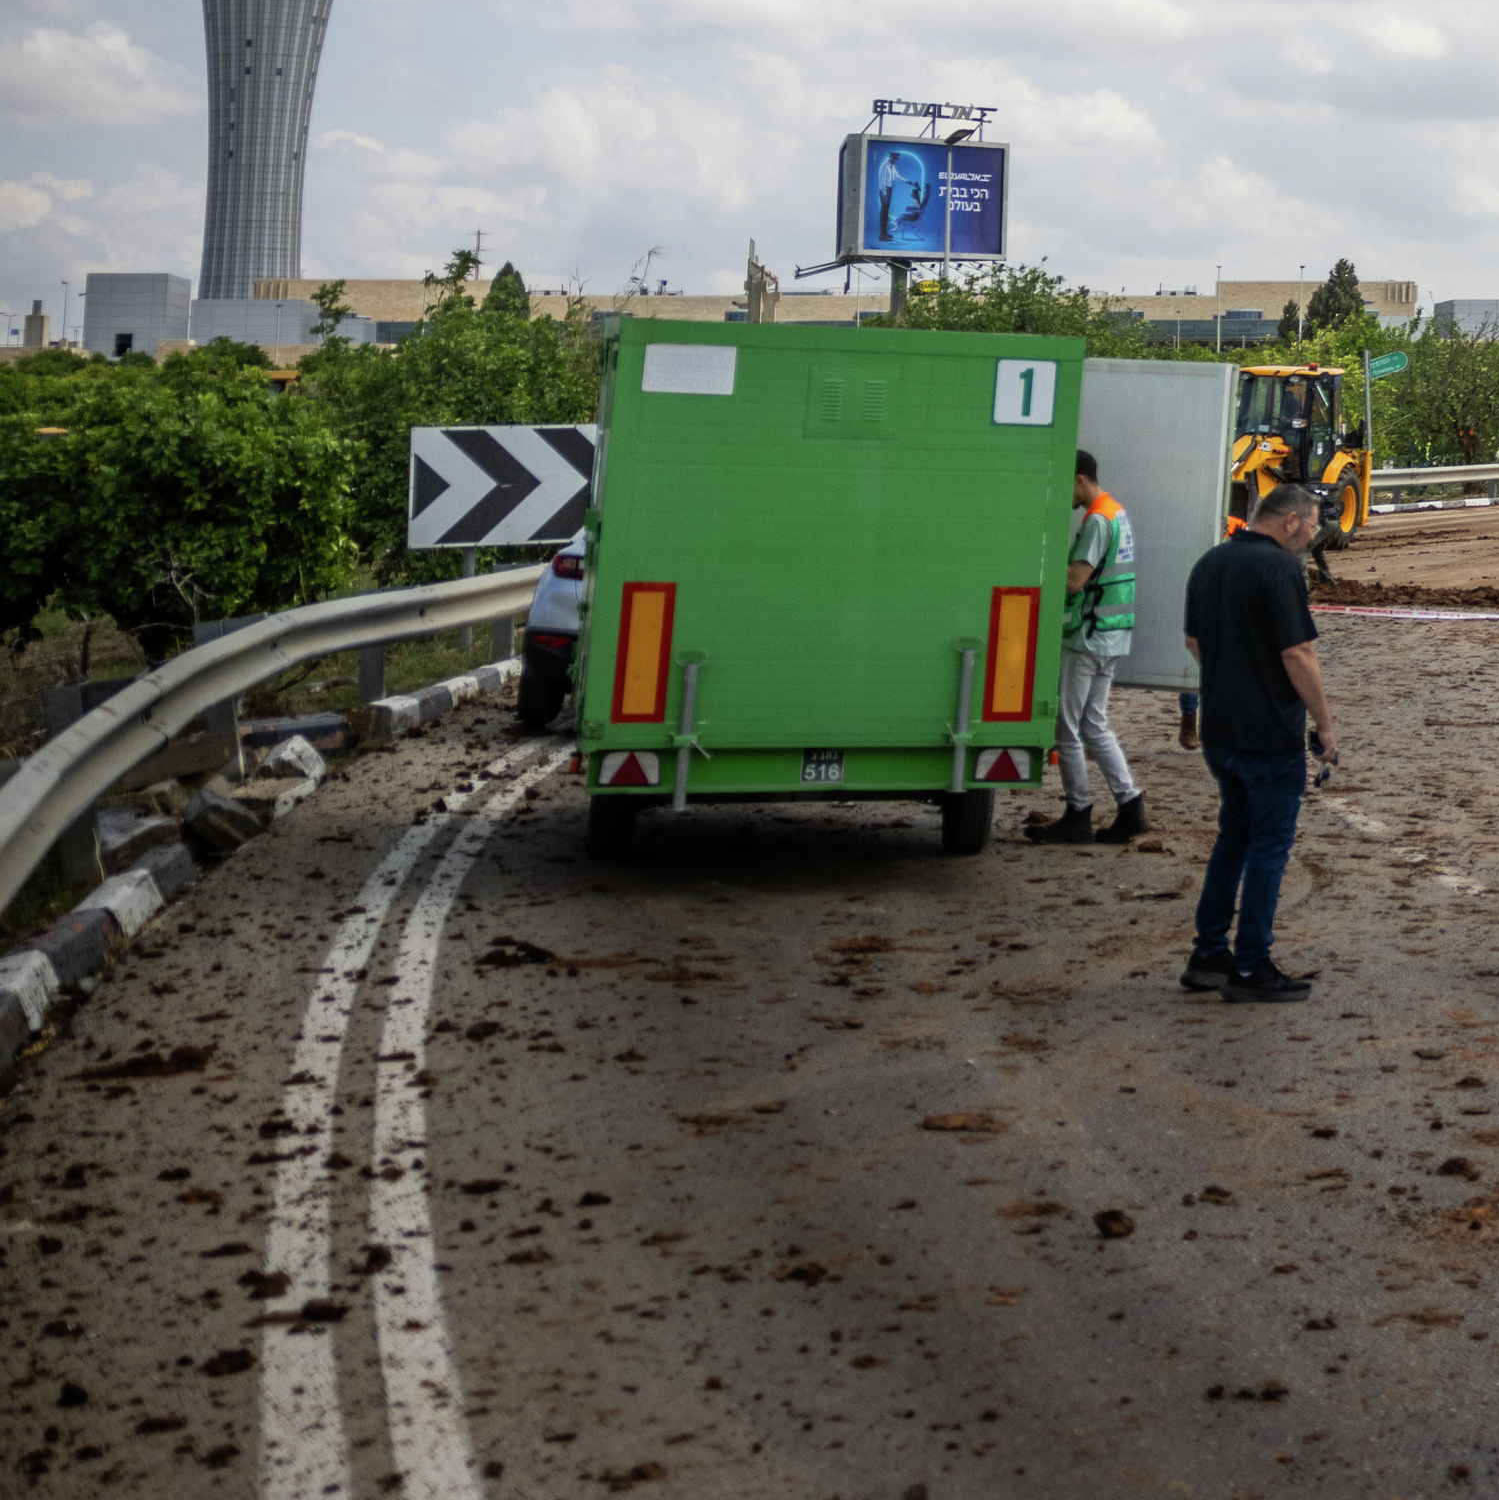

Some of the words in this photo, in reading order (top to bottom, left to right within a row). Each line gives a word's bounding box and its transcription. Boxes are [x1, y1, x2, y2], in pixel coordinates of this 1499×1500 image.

[970, 188, 989, 199] הכי
[1018, 367, 1035, 417] 1
[803, 763, 840, 780] 516
